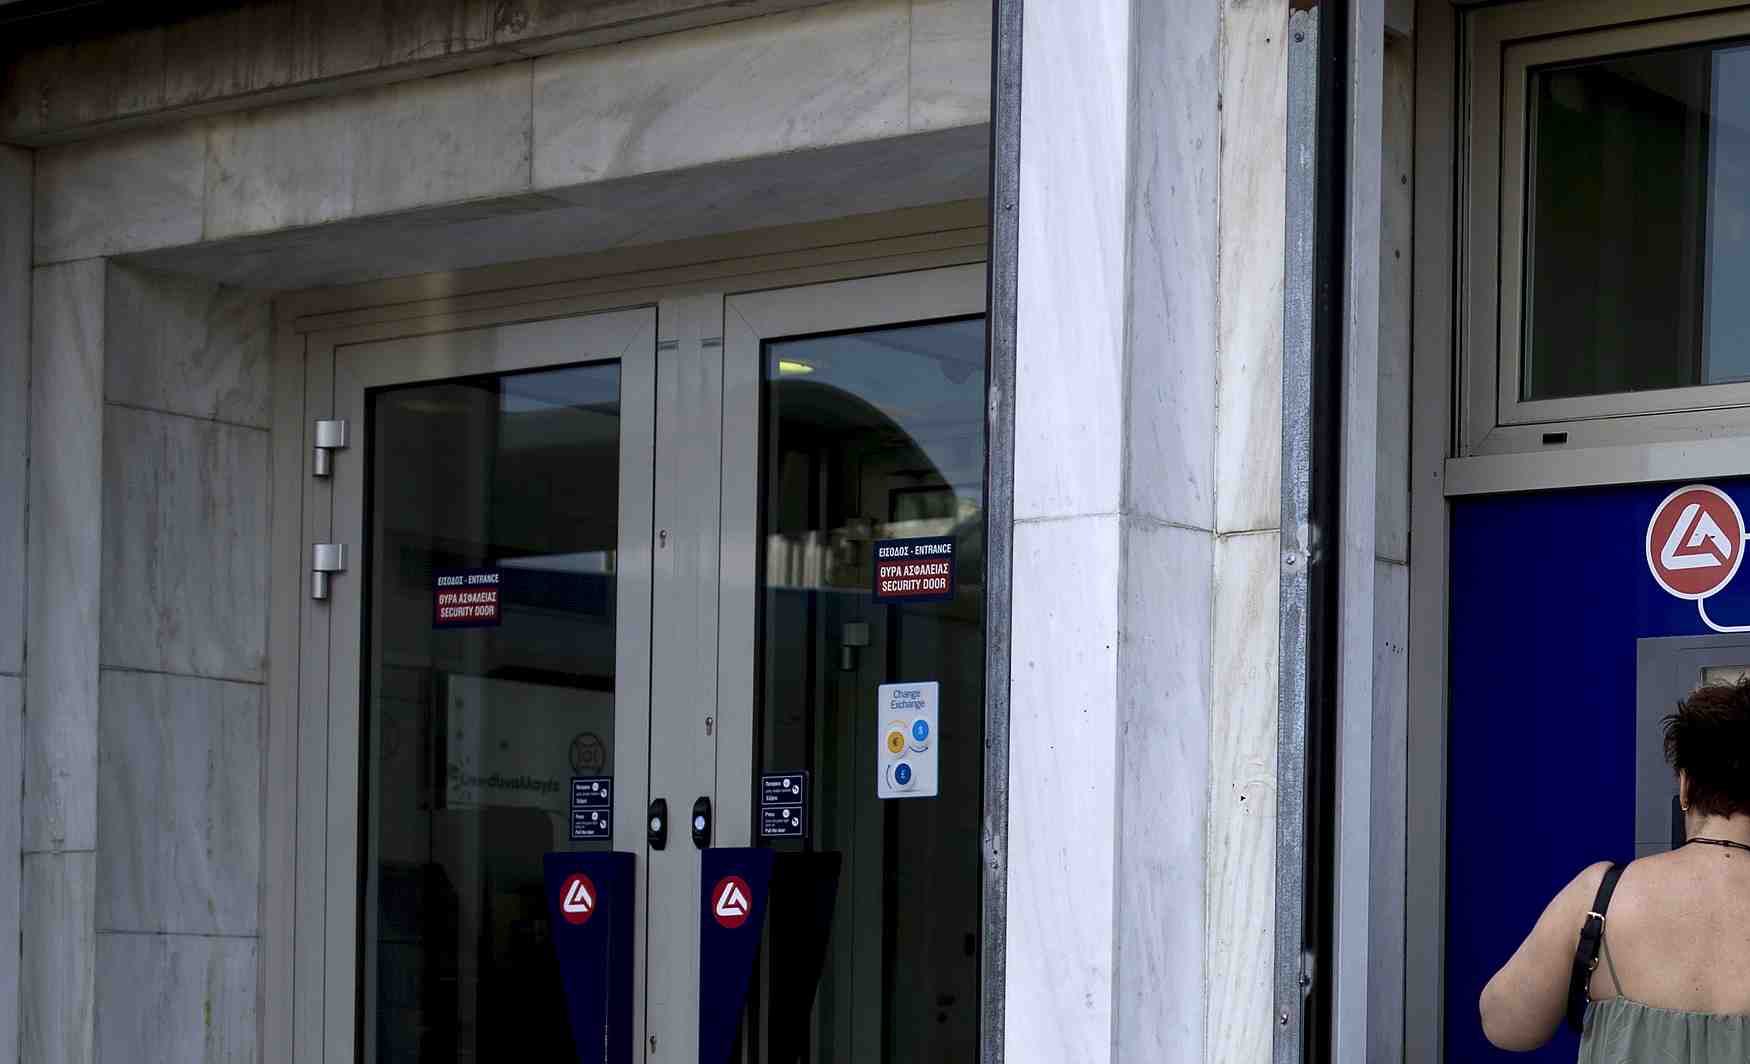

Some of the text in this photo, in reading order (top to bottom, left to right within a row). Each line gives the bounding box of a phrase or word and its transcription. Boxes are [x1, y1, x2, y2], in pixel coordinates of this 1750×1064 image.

[878, 545, 909, 557] ΕΙΣΟΔΟΣ
[914, 543, 952, 555] ENTRANCE
[880, 563, 949, 578] ΘΥΡΑ ΑΣΦΑΛΕΙΑΣ
[468, 573, 499, 584] ENTRANCE
[882, 577, 946, 592] SECURITY DOOR
[440, 605, 495, 618] SECURITY DOOR
